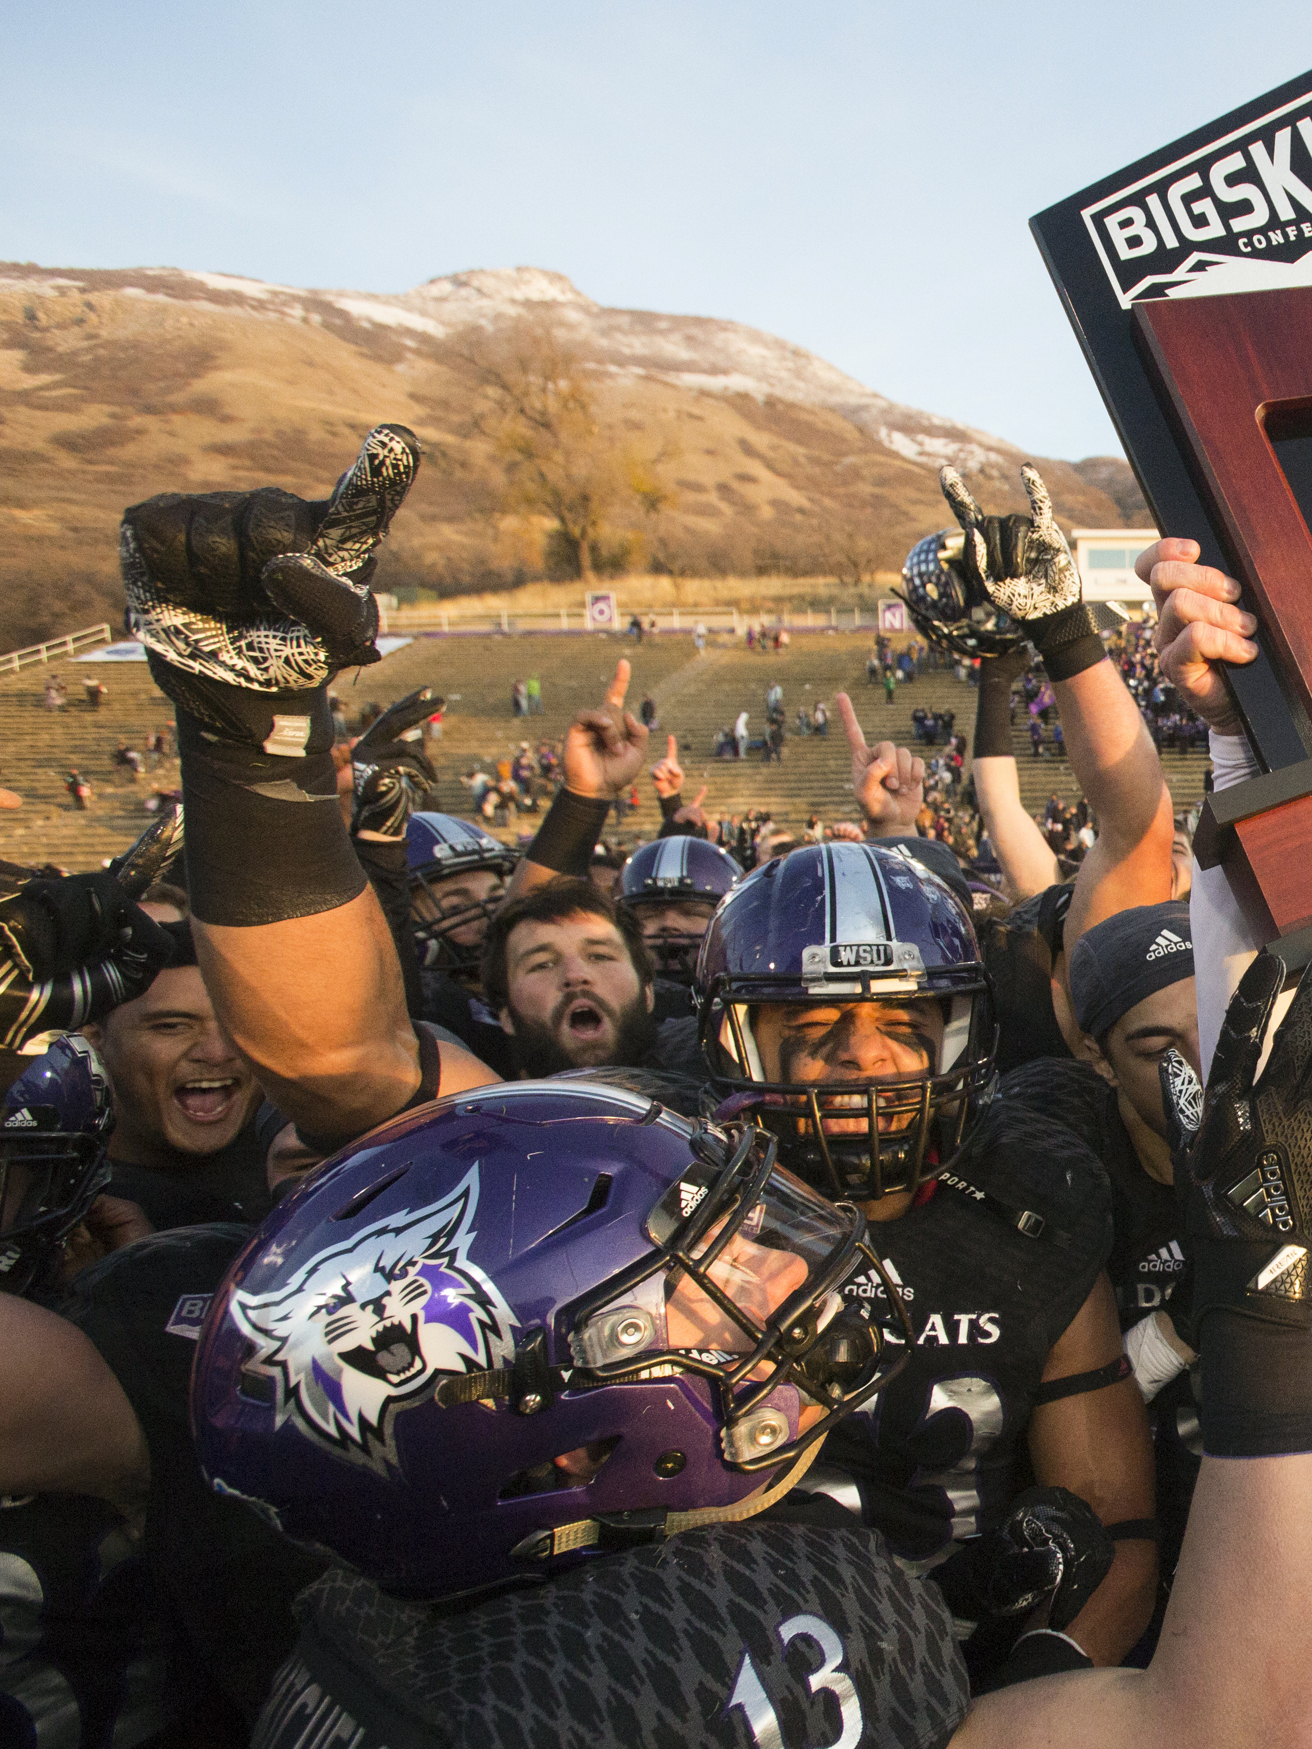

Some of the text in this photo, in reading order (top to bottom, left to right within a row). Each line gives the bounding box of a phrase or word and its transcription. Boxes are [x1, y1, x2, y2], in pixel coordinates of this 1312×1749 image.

[838, 944, 886, 967] WSU
[1146, 940, 1193, 961] adidas
[4, 1119, 38, 1128] adidas
[938, 1172, 977, 1194] PORT
[1263, 1153, 1294, 1232] adidas
[681, 1186, 709, 1218] adidas
[1139, 1259, 1183, 1272] adida
[728, 1613, 864, 1748] 13
